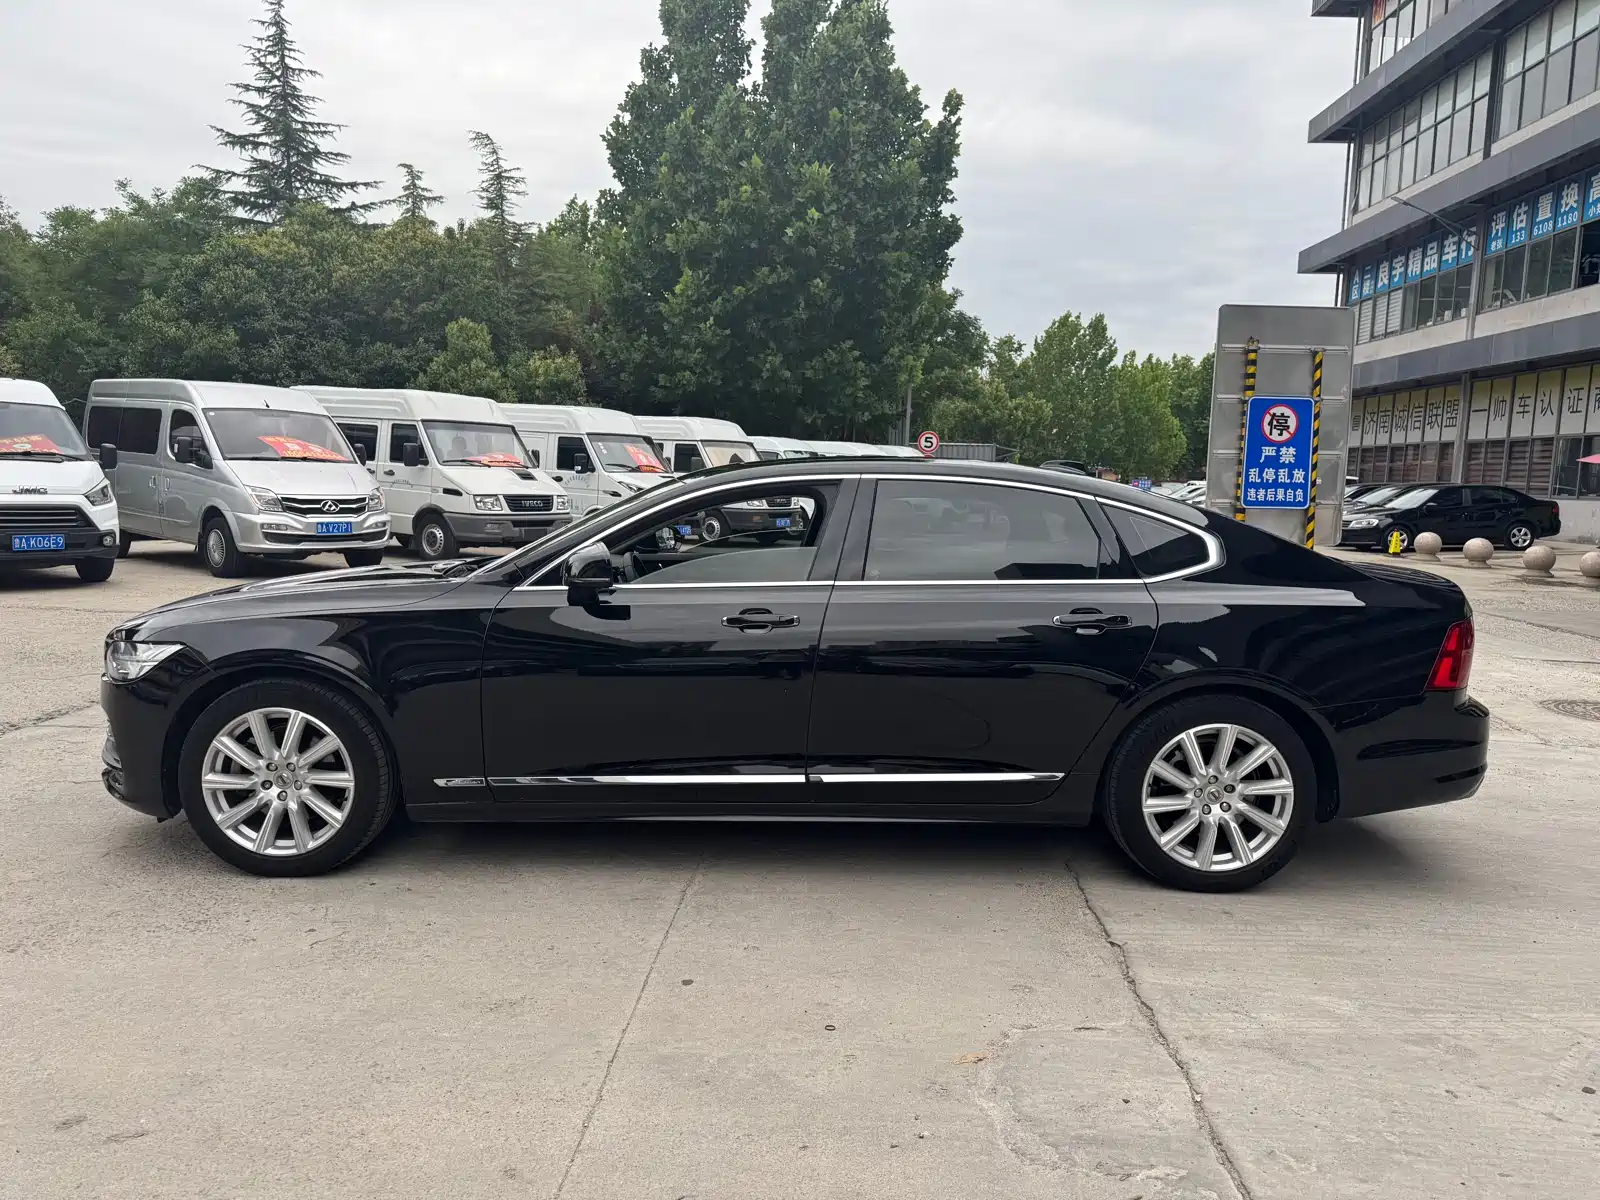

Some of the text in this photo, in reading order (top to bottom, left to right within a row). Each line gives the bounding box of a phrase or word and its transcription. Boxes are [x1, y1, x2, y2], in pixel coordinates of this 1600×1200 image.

[1511, 230, 1525, 244] 133
[1533, 220, 1553, 236] 6108
[1557, 211, 1578, 228] 1180
[1267, 412, 1290, 436] 停
[924, 436, 934, 448] 5
[1259, 446, 1297, 464] 严禁
[1248, 467, 1306, 484] 乱停乱放
[521, 499, 543, 507] IVECO
[1246, 487, 1304, 502] 违者后果自负
